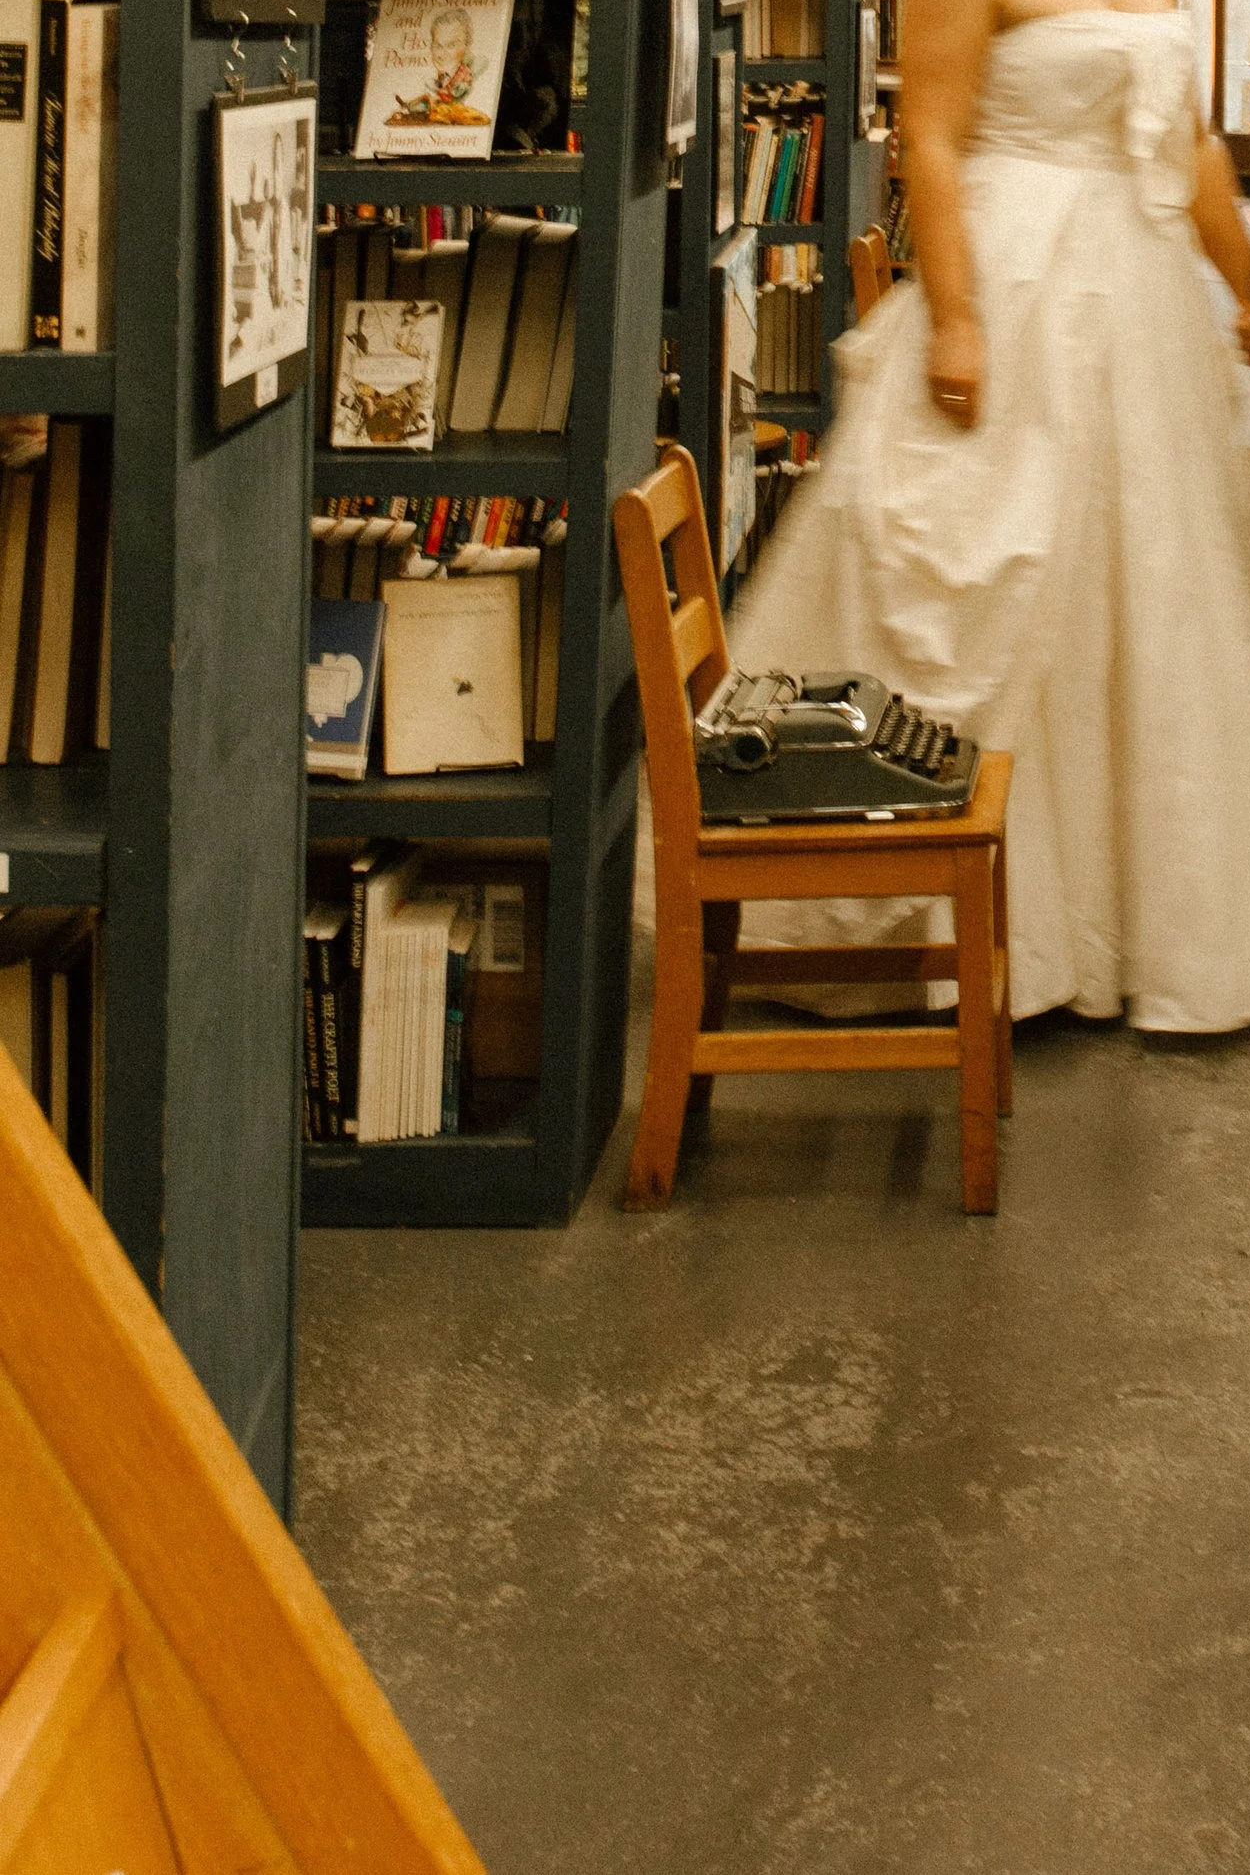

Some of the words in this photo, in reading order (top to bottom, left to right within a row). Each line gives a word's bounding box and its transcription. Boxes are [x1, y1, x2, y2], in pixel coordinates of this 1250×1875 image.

[394, 10, 424, 29] and
[384, 49, 428, 69] Poems
[430, 133, 478, 148] Stewart
[322, 993, 335, 1018] THE
[327, 1072, 339, 1103] POET
